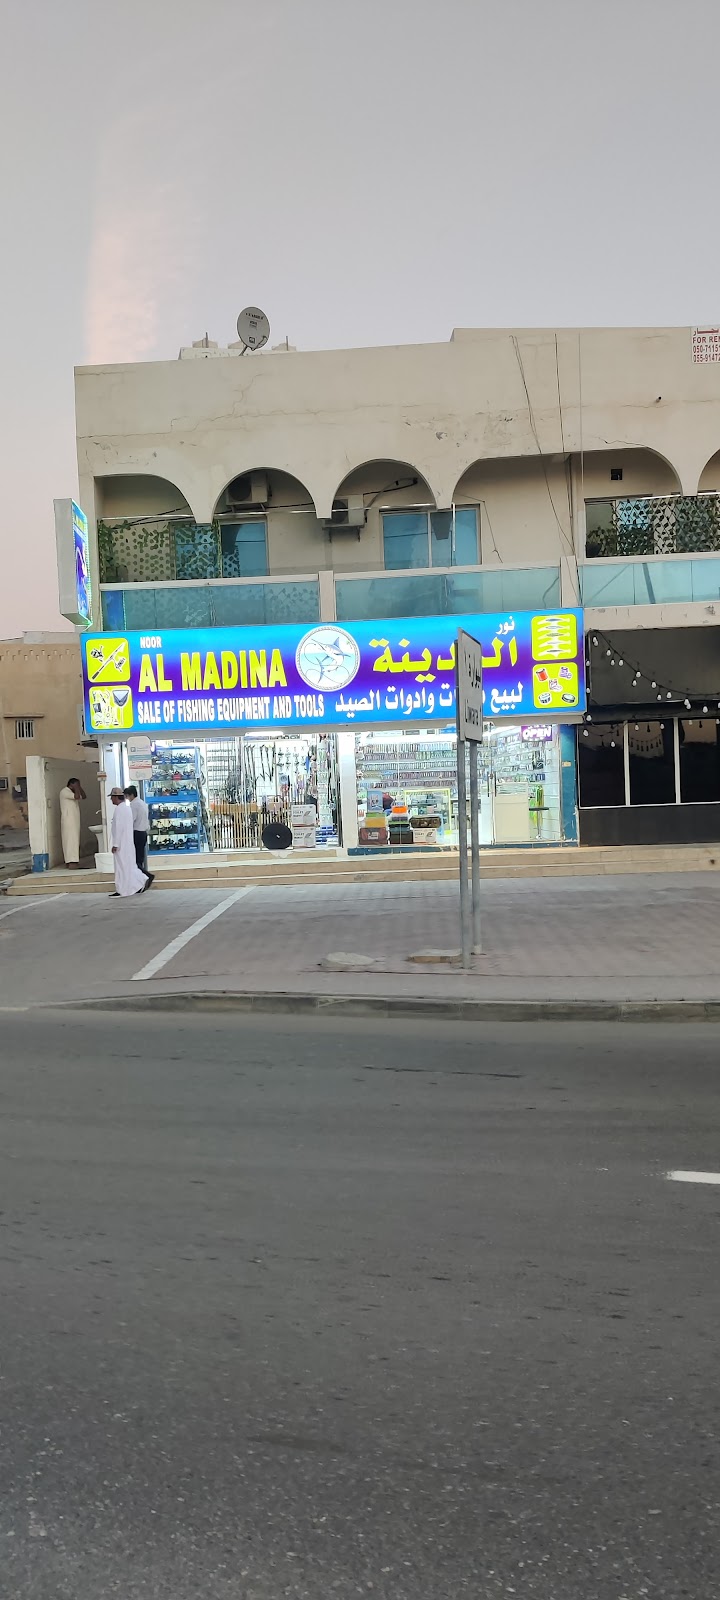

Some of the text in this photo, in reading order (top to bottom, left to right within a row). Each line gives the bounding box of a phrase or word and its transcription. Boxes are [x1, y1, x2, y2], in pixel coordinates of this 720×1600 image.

[495, 615, 515, 635] نور
[140, 636, 162, 649] NOOR
[138, 648, 288, 693] AL MADINA
[368, 636, 518, 683] الدينة
[137, 693, 325, 724] SALE OF FISHING EQUIPMENT AND TOOLS
[335, 688, 380, 718] الصيد
[385, 685, 435, 715] وادوات
[490, 680, 524, 713] لبيع
[522, 726, 551, 740] OPEN
